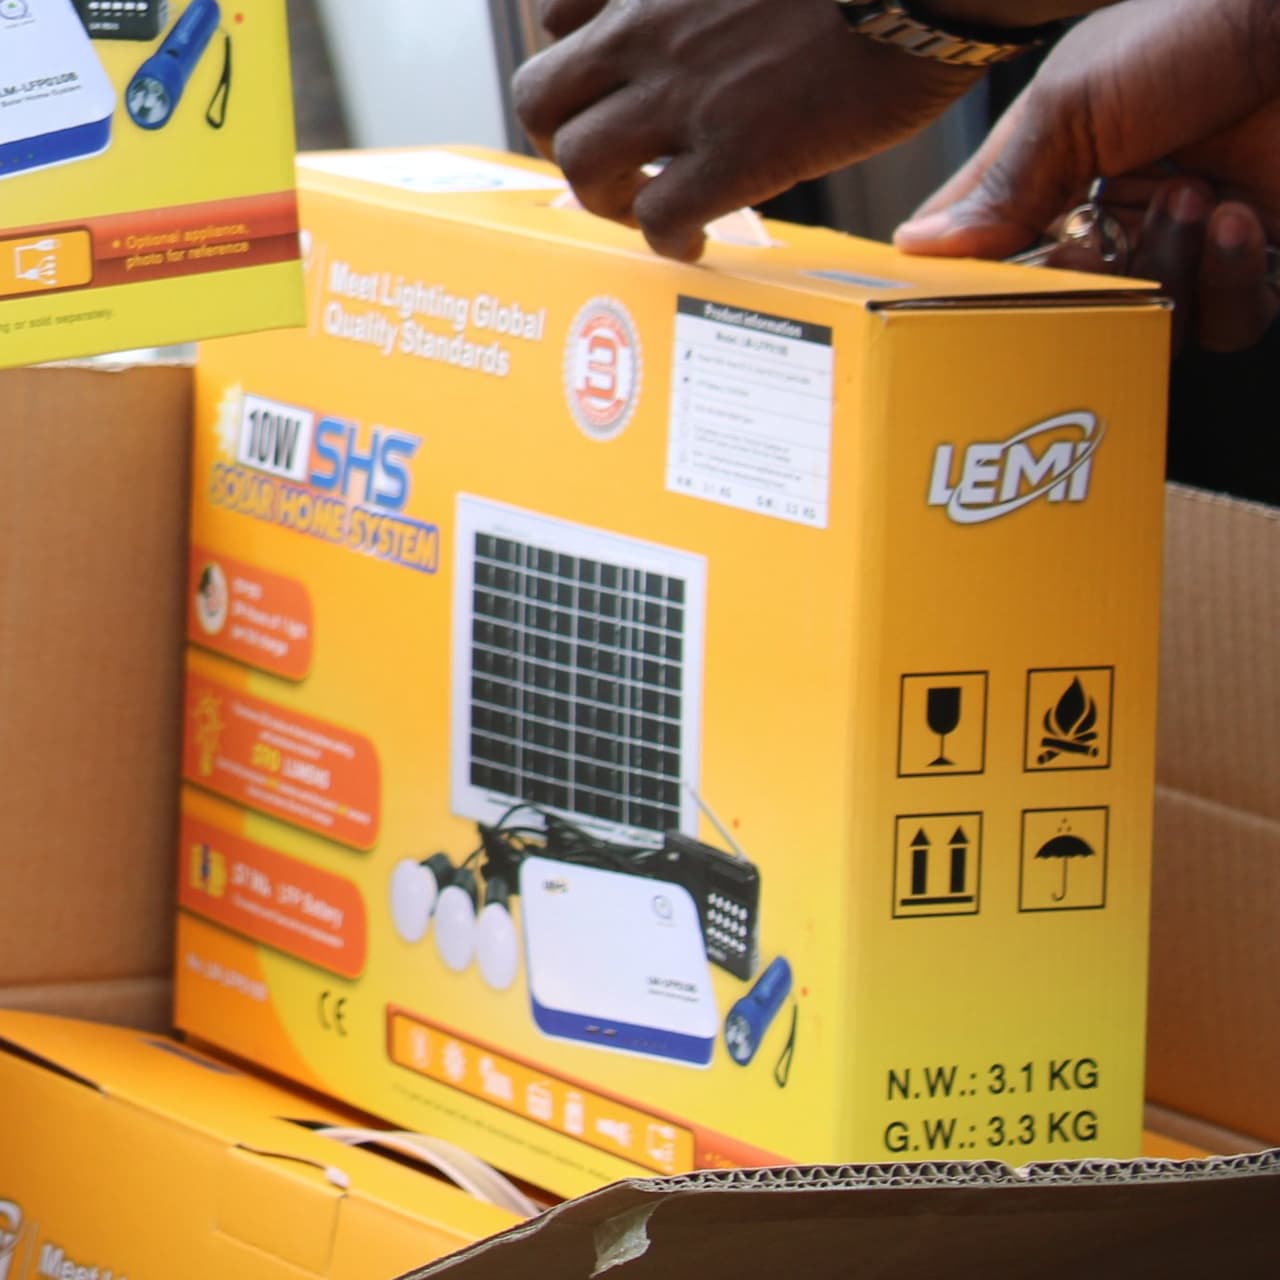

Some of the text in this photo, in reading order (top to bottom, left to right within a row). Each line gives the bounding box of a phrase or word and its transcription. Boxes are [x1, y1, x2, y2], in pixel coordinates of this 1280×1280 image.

[125, 239, 251, 272] photo for reference
[126, 231, 181, 251] Optional
[328, 260, 548, 342] Meet Lighting Global
[324, 301, 512, 378] Quality Standards
[248, 408, 422, 512] 10W SHS
[926, 413, 1104, 523] LEMI
[348, 505, 440, 575] SYSTEM
[987, 1061, 1034, 1095] 3.1
[1048, 1057, 1100, 1092] KG
[986, 1113, 1036, 1148] 3.3
[1047, 1109, 1100, 1144] KG
